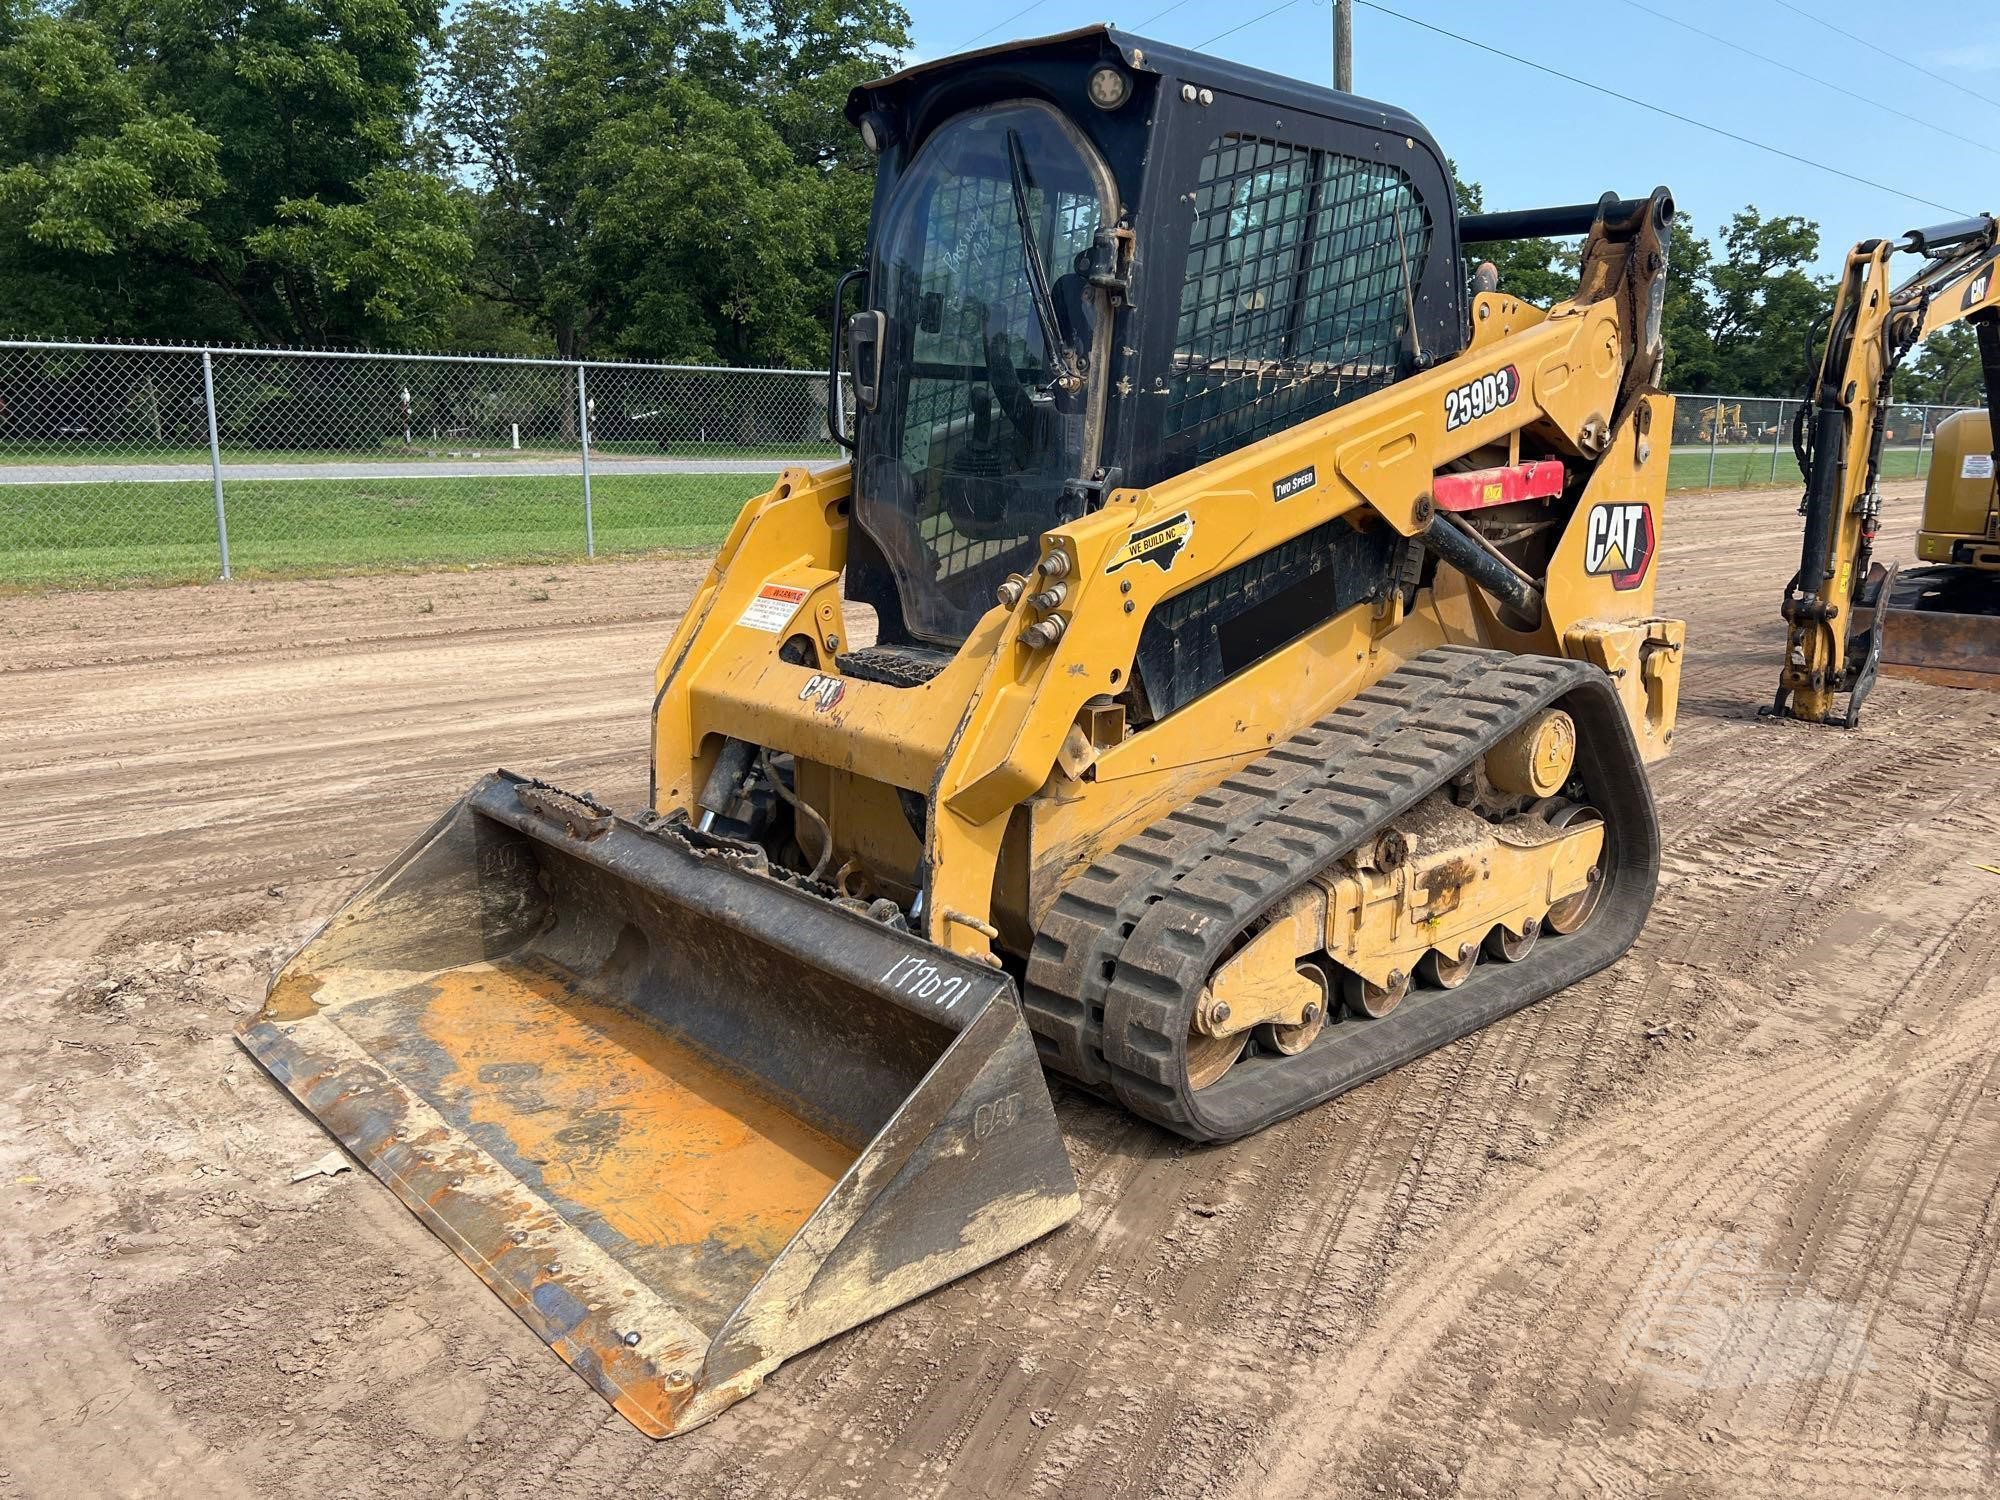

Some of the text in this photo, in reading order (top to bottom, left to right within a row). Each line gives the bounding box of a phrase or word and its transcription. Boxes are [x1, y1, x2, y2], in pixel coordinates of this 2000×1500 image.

[1970, 276, 1987, 304] CAT
[1445, 369, 1510, 431] 259D3
[1128, 528, 1176, 556] WE BUILD NC
[1586, 505, 1643, 573] CAT
[773, 589, 803, 601] WARNING
[799, 674, 844, 706] CAT
[880, 954, 972, 1011] 177071
